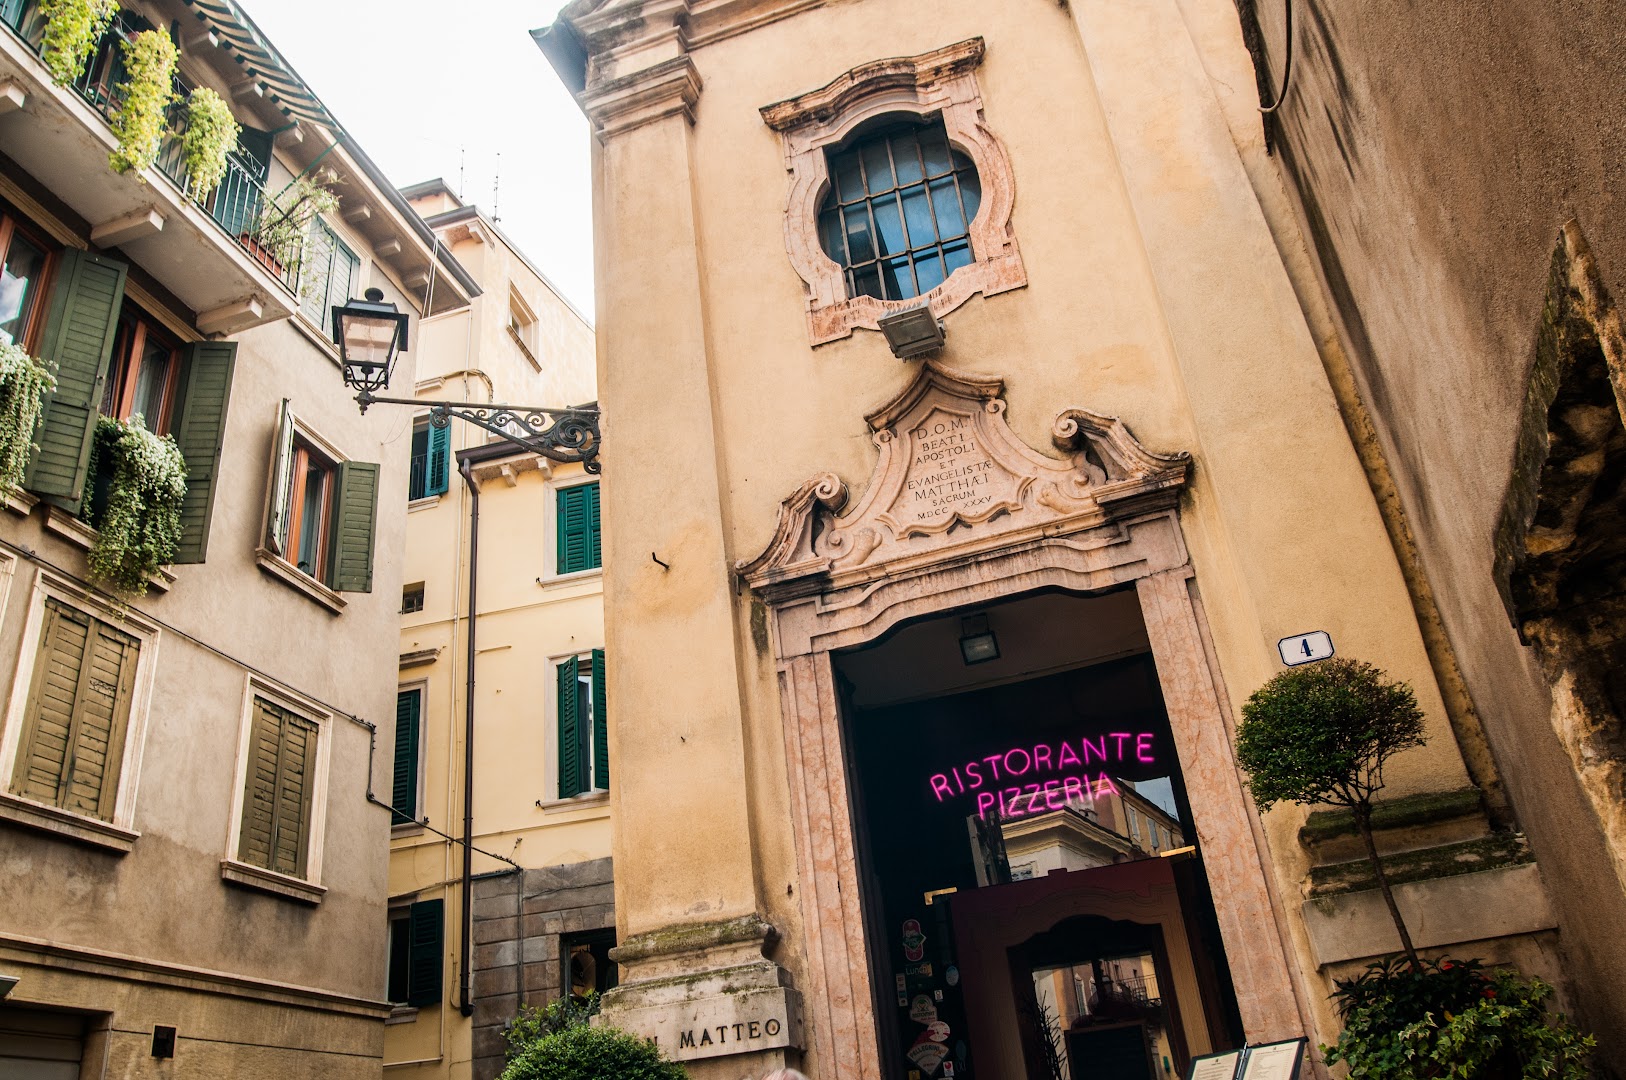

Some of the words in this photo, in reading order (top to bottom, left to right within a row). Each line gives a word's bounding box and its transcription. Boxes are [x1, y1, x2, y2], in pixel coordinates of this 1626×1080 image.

[915, 442, 975, 466] APOSTOLI
[922, 433, 964, 452] BEATI
[939, 459, 955, 470] ET
[917, 507, 949, 520] MDCC
[963, 495, 992, 509] XXXV
[932, 490, 976, 507] SACRUM
[1301, 639, 1313, 656] 4
[930, 732, 1155, 802] RISTORANTE
[977, 771, 1120, 821] PIZZERIA
[679, 1018, 781, 1049] MATTEO
